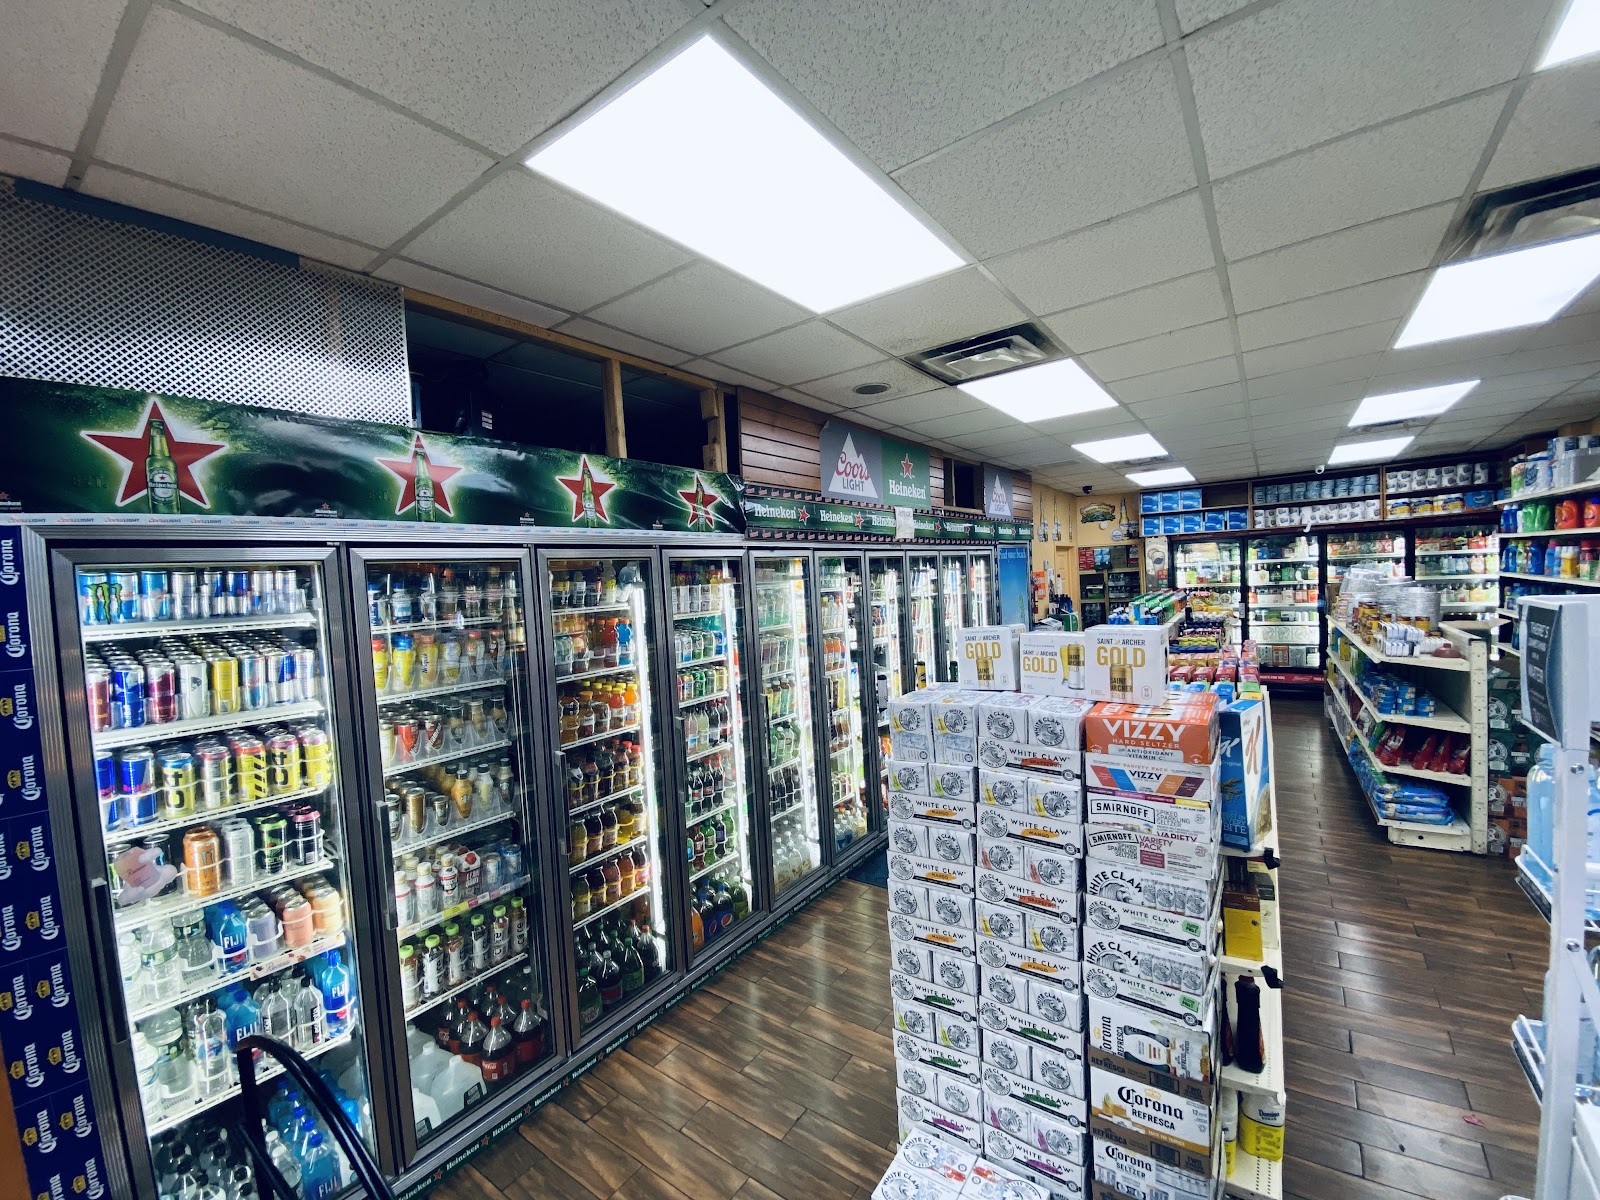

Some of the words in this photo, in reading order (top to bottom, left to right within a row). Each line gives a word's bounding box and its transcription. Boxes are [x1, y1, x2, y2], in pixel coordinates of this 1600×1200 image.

[835, 452, 871, 480] Coors
[842, 479, 865, 492] LIGHT
[888, 479, 927, 500] Heineken
[754, 504, 797, 519] Heineken
[819, 510, 854, 524] Heineken
[871, 514, 896, 527] Heineke
[0, 539, 20, 586] Corona
[6, 611, 27, 658] Corona
[1121, 638, 1146, 646] ARCHER
[965, 641, 1002, 660] GOLD
[1096, 646, 1146, 668] GOLD
[1022, 656, 1058, 673] GOLD
[1111, 677, 1126, 685] SAINT
[1111, 684, 1133, 692] ARCHER
[14, 684, 34, 730] Corona
[1034, 720, 1043, 737] WHITE
[1042, 717, 1061, 726] CLAW
[1102, 719, 1187, 742] VIZZY
[979, 742, 988, 756] WHITE
[989, 740, 1004, 751] CLAW
[1112, 738, 1136, 746] HARD
[1140, 740, 1180, 749] SELTZER
[1127, 748, 1174, 757] ANTIOXIDANT
[1009, 748, 1038, 758] WHITE
[1041, 754, 1067, 762] CLAW
[1127, 753, 1156, 761] VITAMIN
[1123, 763, 1149, 771] VARIETY
[1129, 770, 1162, 780] VIZZY
[21, 754, 42, 801] Corona
[916, 800, 940, 809] WHITE
[942, 804, 964, 812] CLAW
[1096, 802, 1149, 818] SMIRNOFF
[1156, 809, 1178, 818] SPIKED
[980, 810, 988, 825] WHITE
[989, 809, 1006, 821] CLAW
[1156, 814, 1190, 824] SPARKLING
[1156, 819, 1182, 828] SELTZER
[1223, 818, 1247, 826] EVERY
[1010, 819, 1038, 830] WHITE
[1042, 825, 1068, 836] CLAW
[1028, 830, 1050, 839] MANGO
[1223, 824, 1247, 834] BITE
[1092, 832, 1133, 843] SMIRNOFF
[1118, 842, 1138, 851] SPIKED
[1140, 834, 1173, 847] VARIETY
[1140, 841, 1162, 852] PACK
[30, 825, 51, 872] Corona
[1107, 845, 1137, 856] SPARKLING
[1115, 851, 1138, 860] SELTZER
[916, 862, 939, 871] WHITE
[942, 867, 964, 876] CLAW
[1007, 884, 1035, 896] WHITE
[1039, 893, 1065, 904] CLAW
[1099, 900, 1118, 913] CLAW
[40, 895, 60, 941] Corona
[1122, 907, 1149, 919] WHITE
[1152, 915, 1177, 925] CLAW
[2, 904, 23, 951] Corona
[915, 923, 939, 934] WHITE
[942, 930, 964, 939] CLAW
[223, 929, 245, 949] FIJI
[1009, 950, 1036, 963] WHITE
[1041, 960, 1067, 971] CLAW
[1027, 964, 1048, 972] MANGO
[1086, 968, 1096, 983] WHITE
[1097, 968, 1115, 982] CLAW
[50, 963, 71, 1008] Corona
[915, 984, 938, 996] WHITE
[941, 993, 962, 1004] CLAW
[1120, 977, 1146, 989] WHITE
[1149, 987, 1173, 997] CLAW
[13, 975, 33, 1021] Corona
[1010, 1014, 1037, 1029] WHITE
[1041, 1027, 1067, 1040] CLAW
[1101, 1015, 1113, 1051] orona
[1116, 1026, 1125, 1058] REFRESCA
[61, 1029, 81, 1074] Corona
[920, 1045, 944, 1058] WHITE
[948, 1054, 969, 1066] CLAW
[24, 1042, 45, 1088] Corona
[1091, 1056, 1126, 1074] REFRESCA
[534, 1082, 562, 1107] Heineken
[1012, 1080, 1041, 1095] WHITE
[1044, 1093, 1070, 1106] CLAW
[1117, 1086, 1184, 1120] Corona
[73, 1094, 93, 1138] Corona
[924, 1106, 947, 1120] WHITE
[950, 1119, 972, 1131] CLAW
[1131, 1108, 1176, 1131] REFRESCA
[1258, 1109, 1280, 1117] Domino
[37, 1109, 58, 1154] Corona
[492, 1110, 523, 1138] Heineken
[904, 1137, 922, 1150] WHITE
[923, 1138, 939, 1153] CLAW
[1093, 1127, 1128, 1145] REFRESCA
[446, 1140, 480, 1171] Heineken
[1015, 1144, 1042, 1160] WHITE
[1046, 1159, 1071, 1173] CLAW
[1105, 1145, 1152, 1172] Corona
[85, 1157, 105, 1200] Corona
[1116, 1162, 1146, 1179] SELTZER
[882, 1172, 901, 1186] WHITE
[903, 1173, 920, 1190] CLAW
